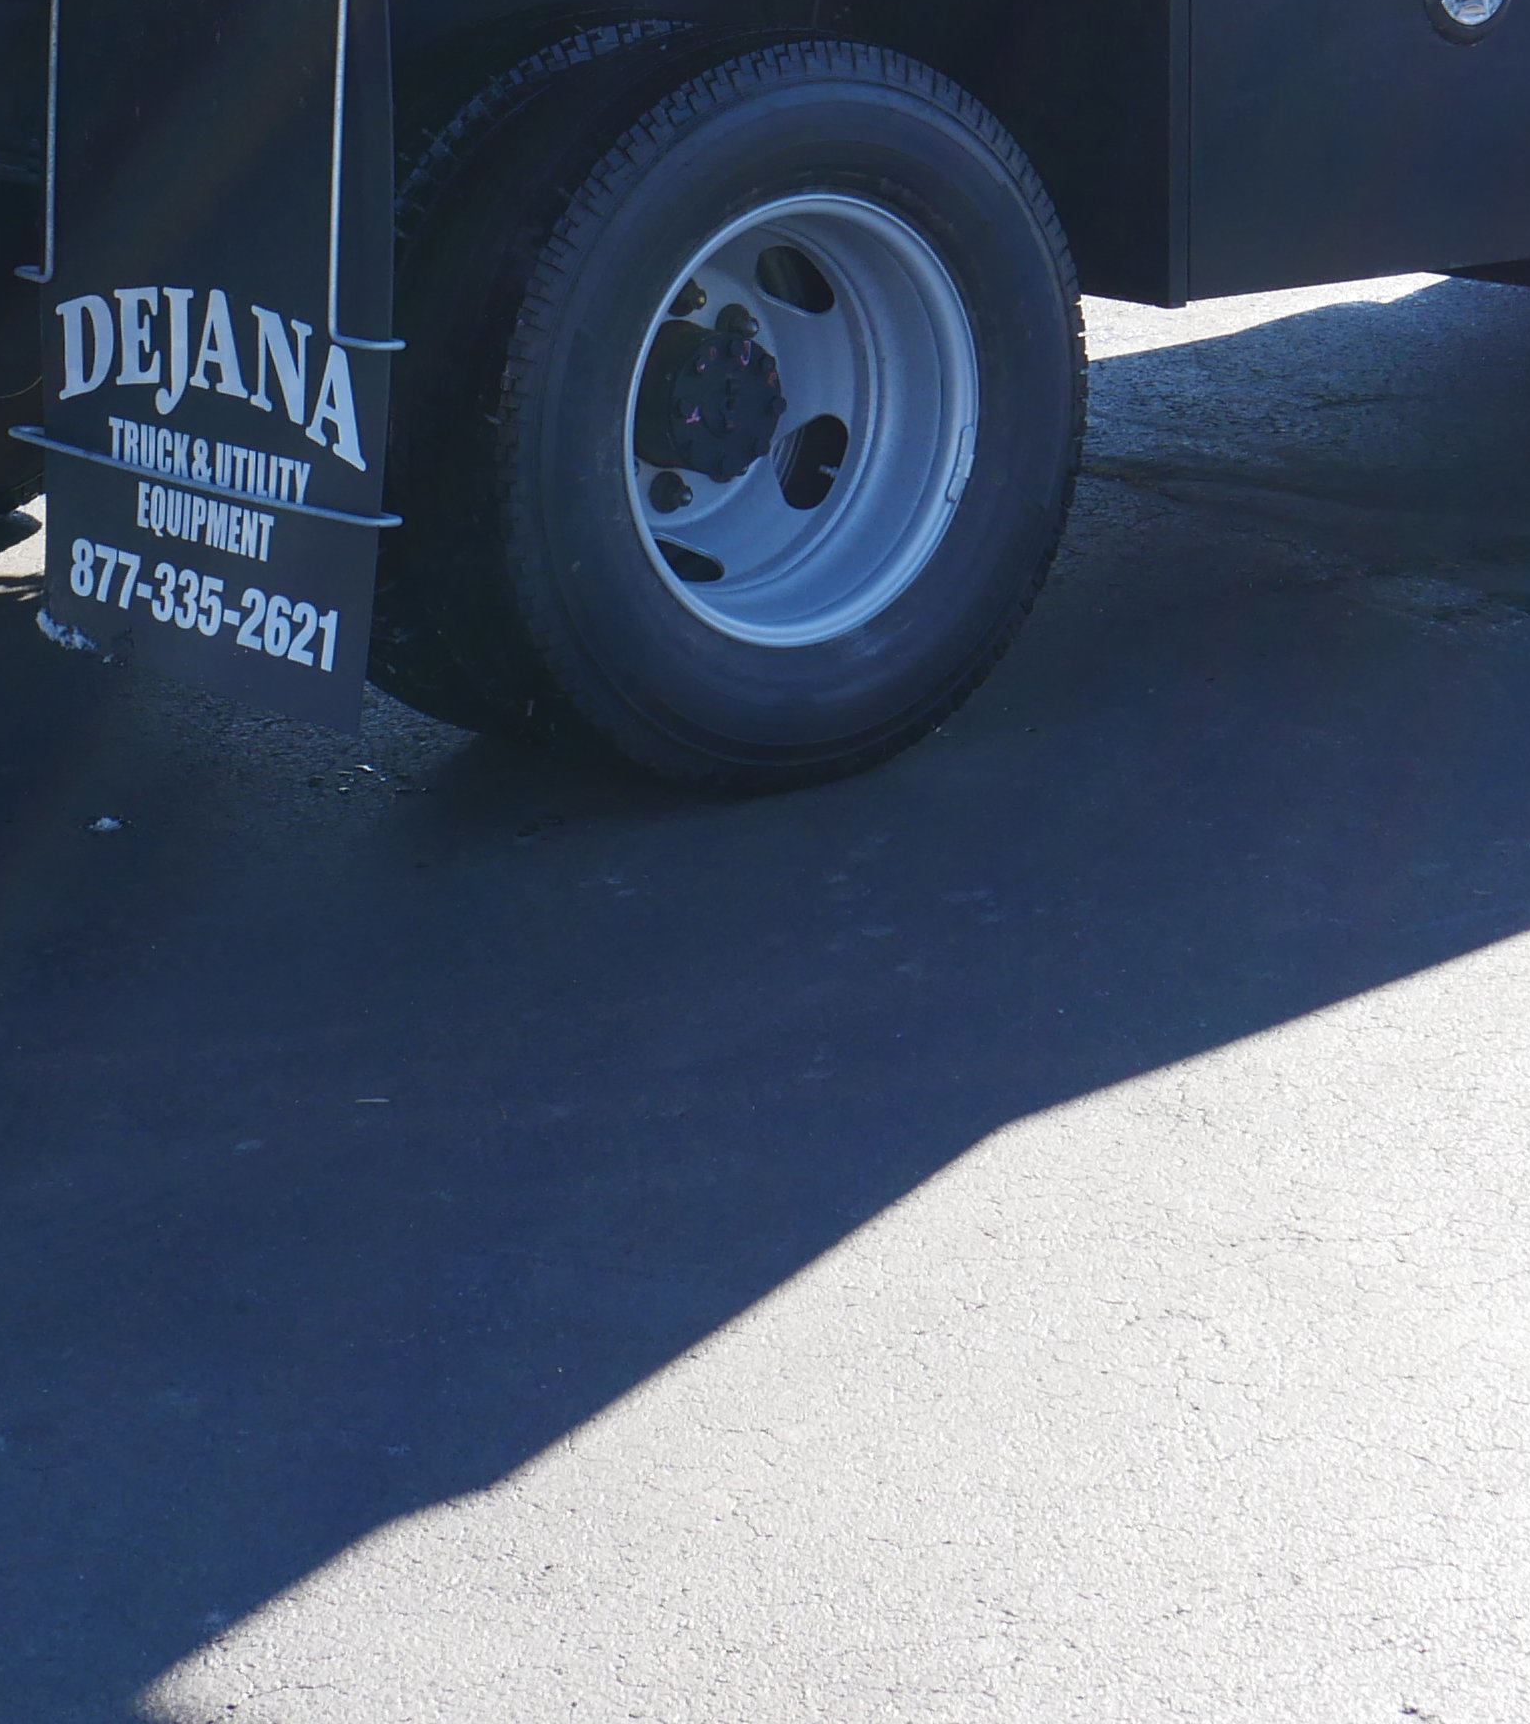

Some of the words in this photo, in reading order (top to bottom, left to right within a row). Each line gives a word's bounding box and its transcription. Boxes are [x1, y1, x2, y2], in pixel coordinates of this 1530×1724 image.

[55, 286, 367, 472] DEJANA
[108, 416, 191, 479] TRUCK
[192, 438, 213, 480] &
[215, 442, 312, 505] UTILITY
[137, 481, 275, 563] EQUIPMENT
[69, 537, 340, 673] 877-335-2621
